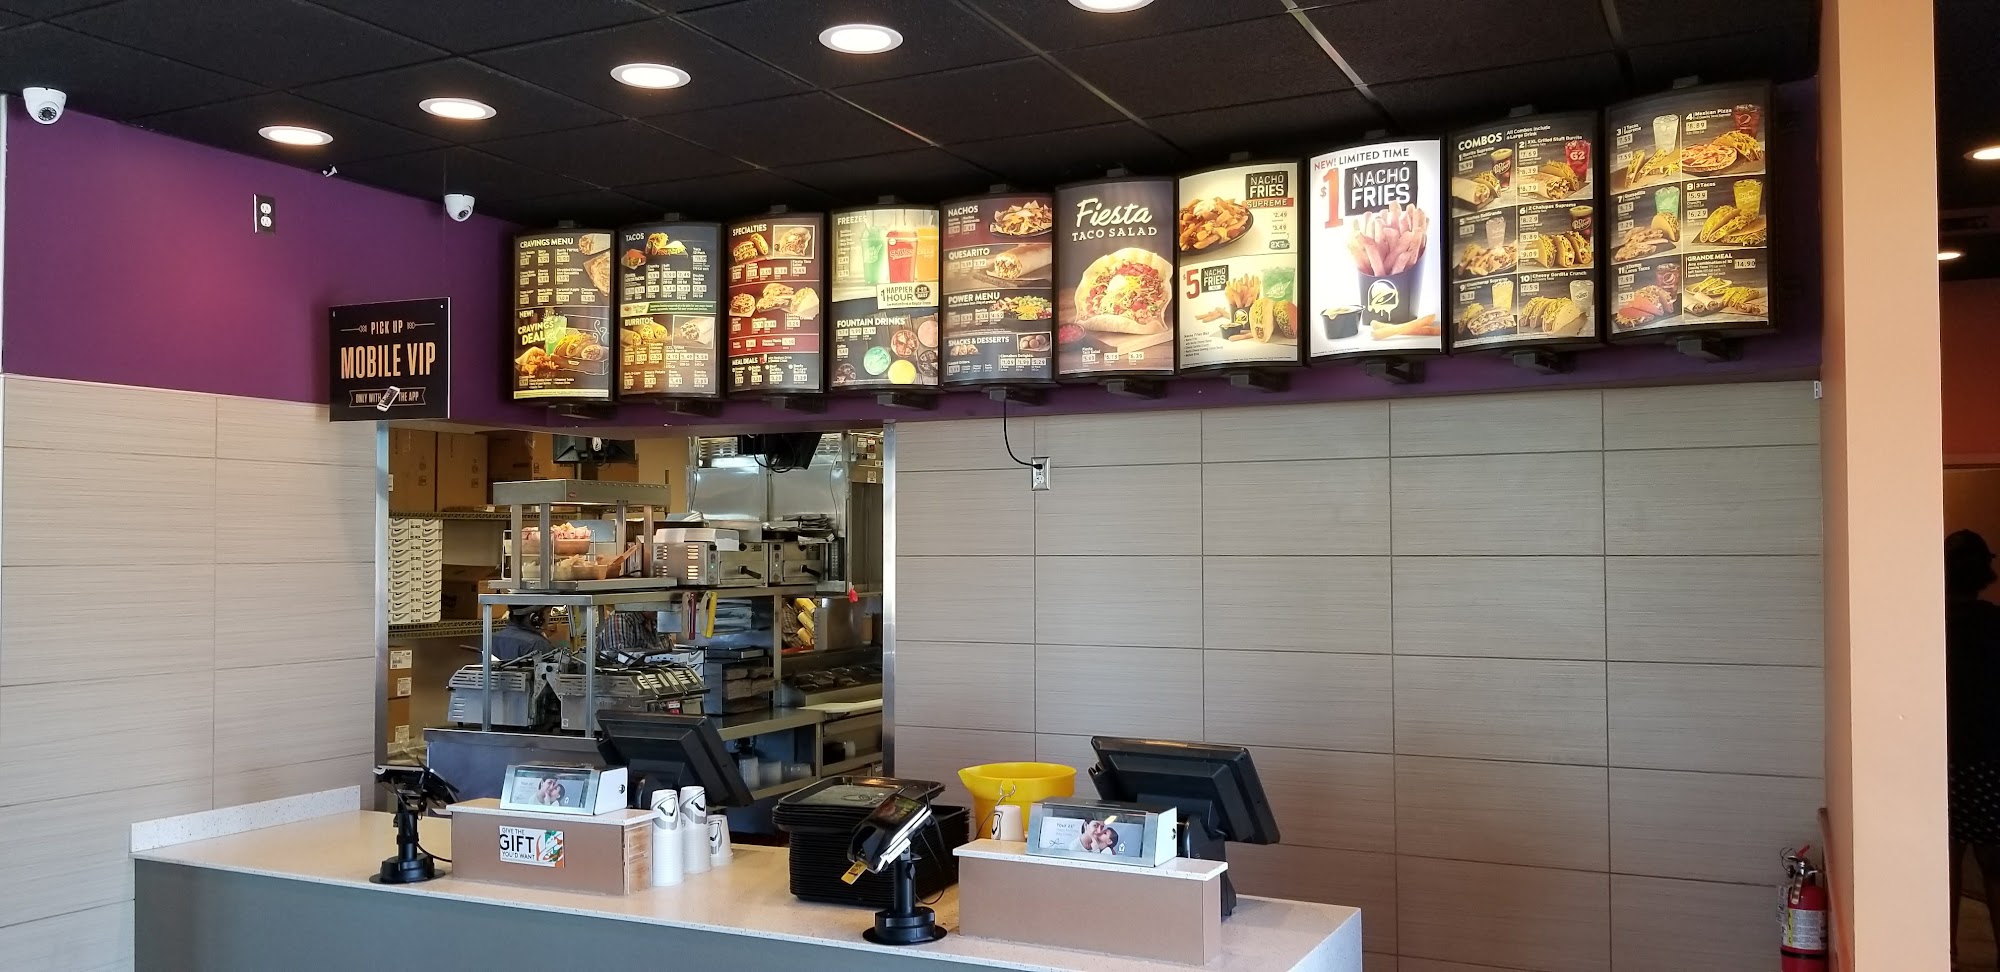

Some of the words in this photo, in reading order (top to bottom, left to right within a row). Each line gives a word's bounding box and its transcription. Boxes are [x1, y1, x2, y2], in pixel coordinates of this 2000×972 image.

[1458, 133, 1502, 151] COMBOS
[1314, 158, 1336, 171] NEW!
[1339, 150, 1380, 165] LIMITED
[1383, 148, 1410, 158] TIME
[1570, 151, 1585, 160] G2
[1250, 175, 1283, 185] NACHO
[1352, 167, 1410, 188] NACHO
[1250, 184, 1284, 198] FRIES
[1352, 184, 1410, 209] FRIES
[1246, 199, 1287, 208] SUPREME
[948, 206, 978, 217] NACHOS
[1076, 198, 1152, 228] Fiesta
[838, 216, 867, 225] FREEZES
[733, 224, 767, 236] SPECIALTIES
[1072, 230, 1104, 241] TACO
[1108, 227, 1157, 238] SALAD
[626, 233, 644, 241] TACOS
[520, 239, 550, 248] CRAVINGS
[949, 248, 990, 260] QUESARITO
[1204, 268, 1226, 276] NACHO
[1619, 266, 1624, 274] 11
[1204, 275, 1226, 286] FRIES
[887, 286, 912, 294] HAPPIER
[948, 294, 973, 304] POWER
[975, 292, 1000, 300] MENU
[519, 310, 534, 318] NEW!
[625, 317, 654, 326] BURRITOS
[837, 318, 873, 328] FOUNTAIN
[371, 321, 389, 335] PICK
[393, 320, 403, 333] UP
[518, 321, 554, 334] CRAVINGS
[948, 339, 970, 347] SNACKS
[341, 344, 401, 379] MOBILE
[407, 342, 436, 375] VIP
[356, 394, 367, 403] ONLY
[369, 393, 381, 402] WITH
[399, 392, 407, 401] THE
[409, 392, 418, 401] APP
[500, 834, 534, 853] GIFT
